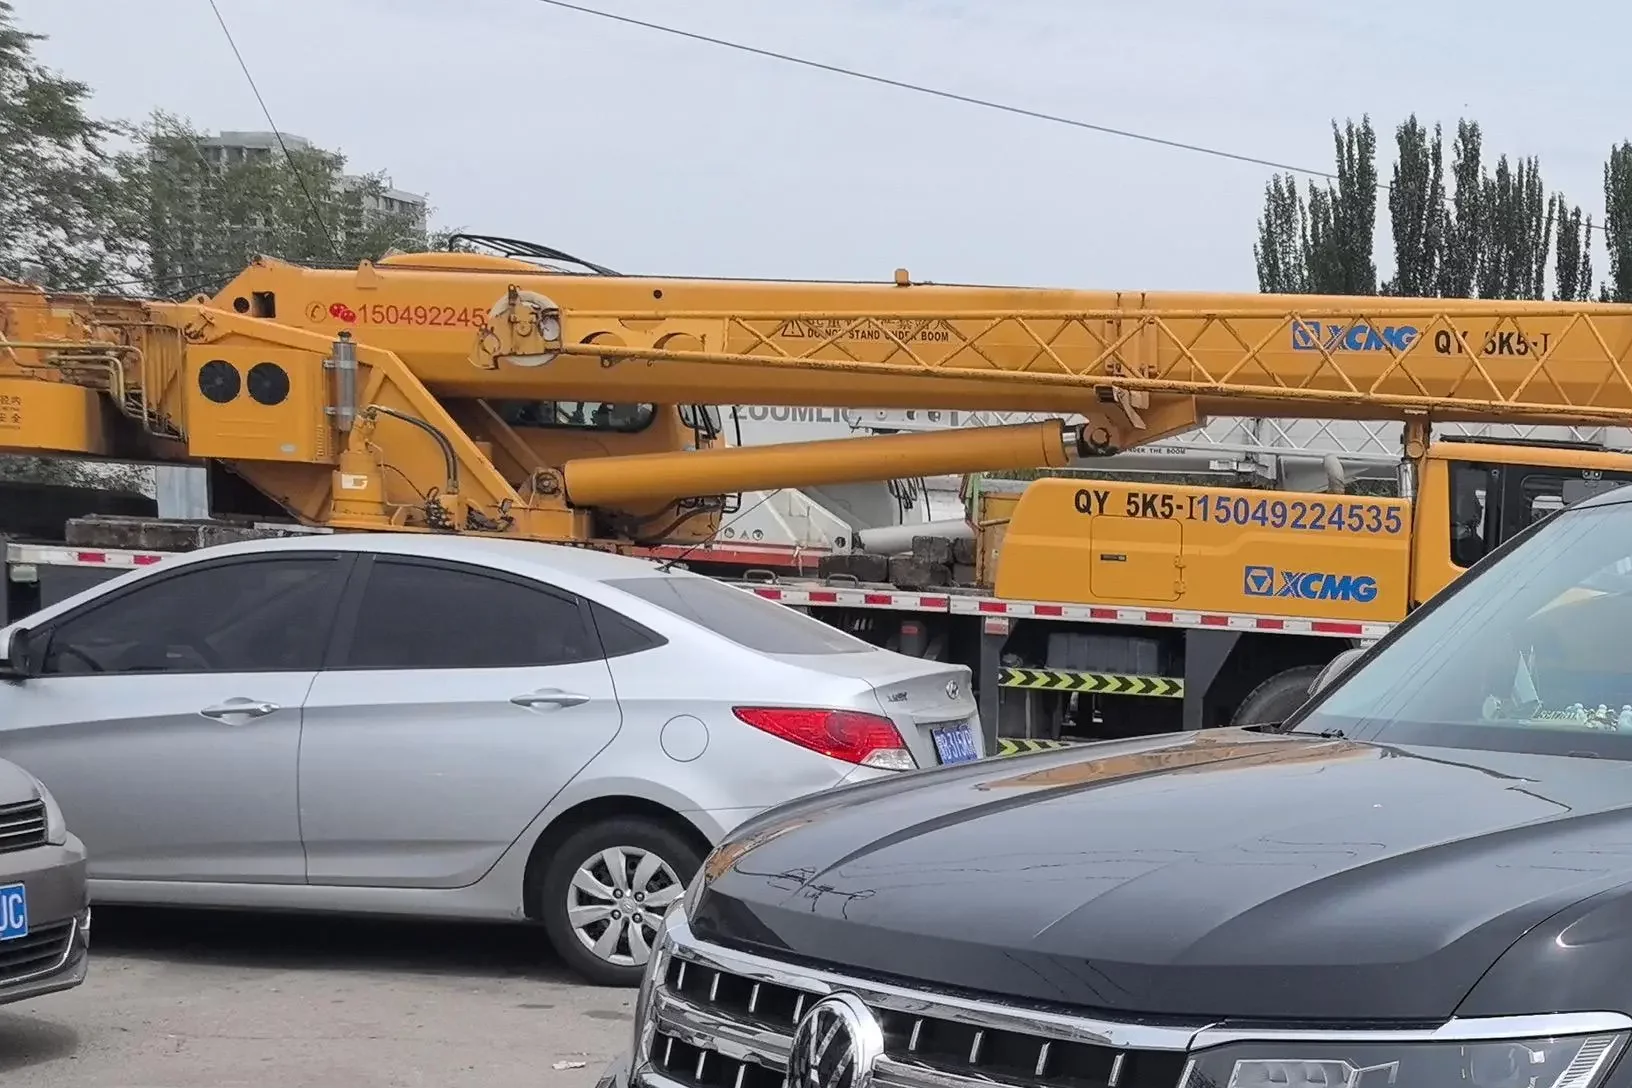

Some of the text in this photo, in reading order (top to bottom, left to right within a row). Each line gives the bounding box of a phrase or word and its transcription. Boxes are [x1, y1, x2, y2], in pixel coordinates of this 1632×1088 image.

[849, 330, 880, 340] STAND
[921, 331, 949, 341] BOOM
[1325, 325, 1419, 351] XCMG
[1074, 489, 1110, 515] QY
[1197, 494, 1402, 534] 15049224535
[1275, 571, 1378, 603] XCMG
